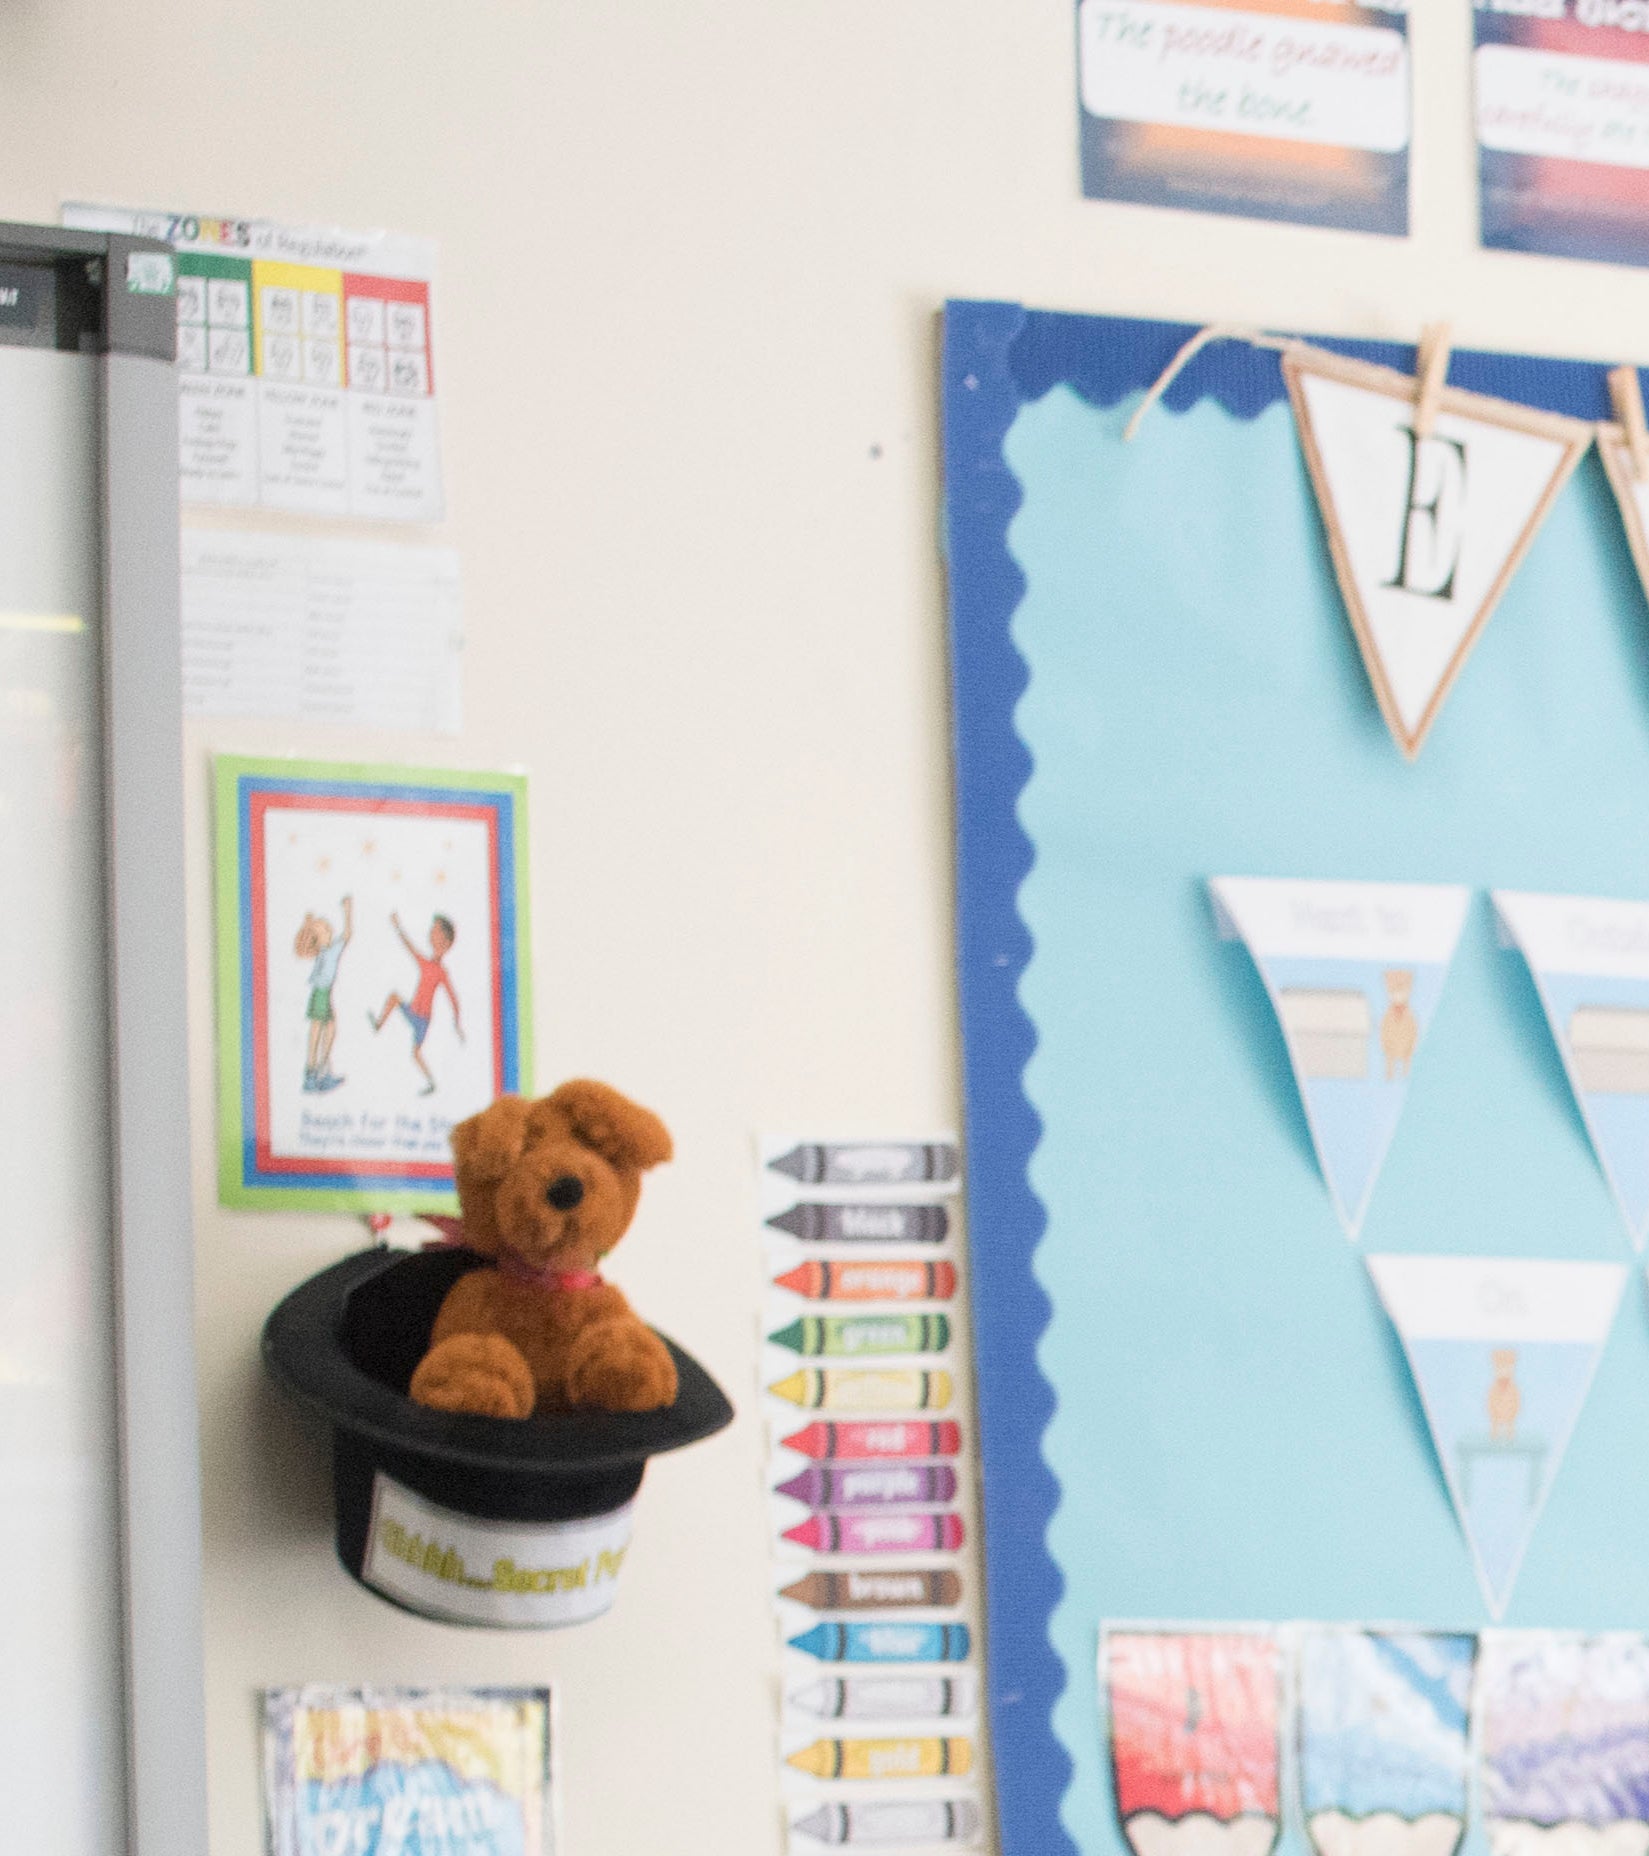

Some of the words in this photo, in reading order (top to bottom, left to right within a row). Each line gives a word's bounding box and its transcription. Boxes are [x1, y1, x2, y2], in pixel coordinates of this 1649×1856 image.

[1096, 11, 1157, 50] The
[1177, 76, 1230, 117] the
[164, 213, 251, 248] ZONES
